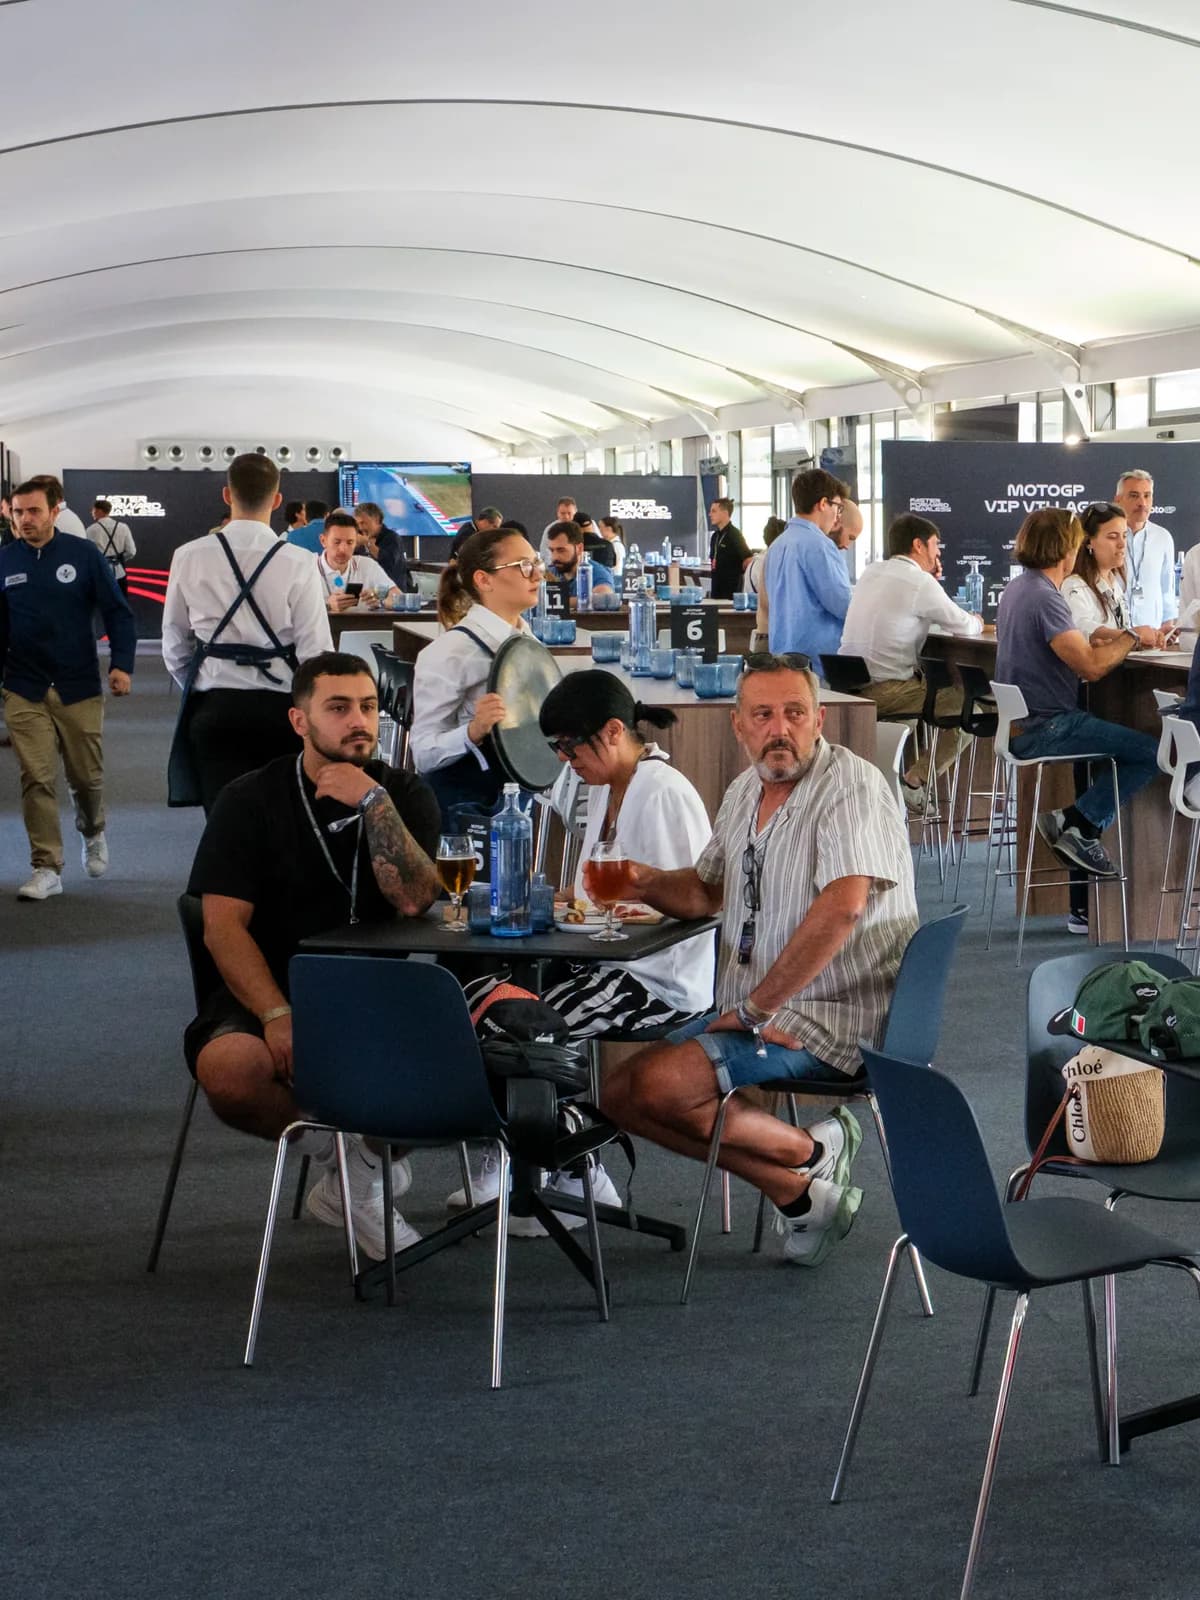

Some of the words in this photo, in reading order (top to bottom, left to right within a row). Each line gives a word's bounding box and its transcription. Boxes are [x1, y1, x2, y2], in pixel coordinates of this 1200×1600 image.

[1007, 484, 1085, 497] MOTOGP
[984, 500, 1020, 513] VIP
[1023, 500, 1103, 513] VIAG
[1149, 505, 1176, 514] otoGP
[687, 619, 703, 641] 6
[1064, 1059, 1103, 1078] hloé
